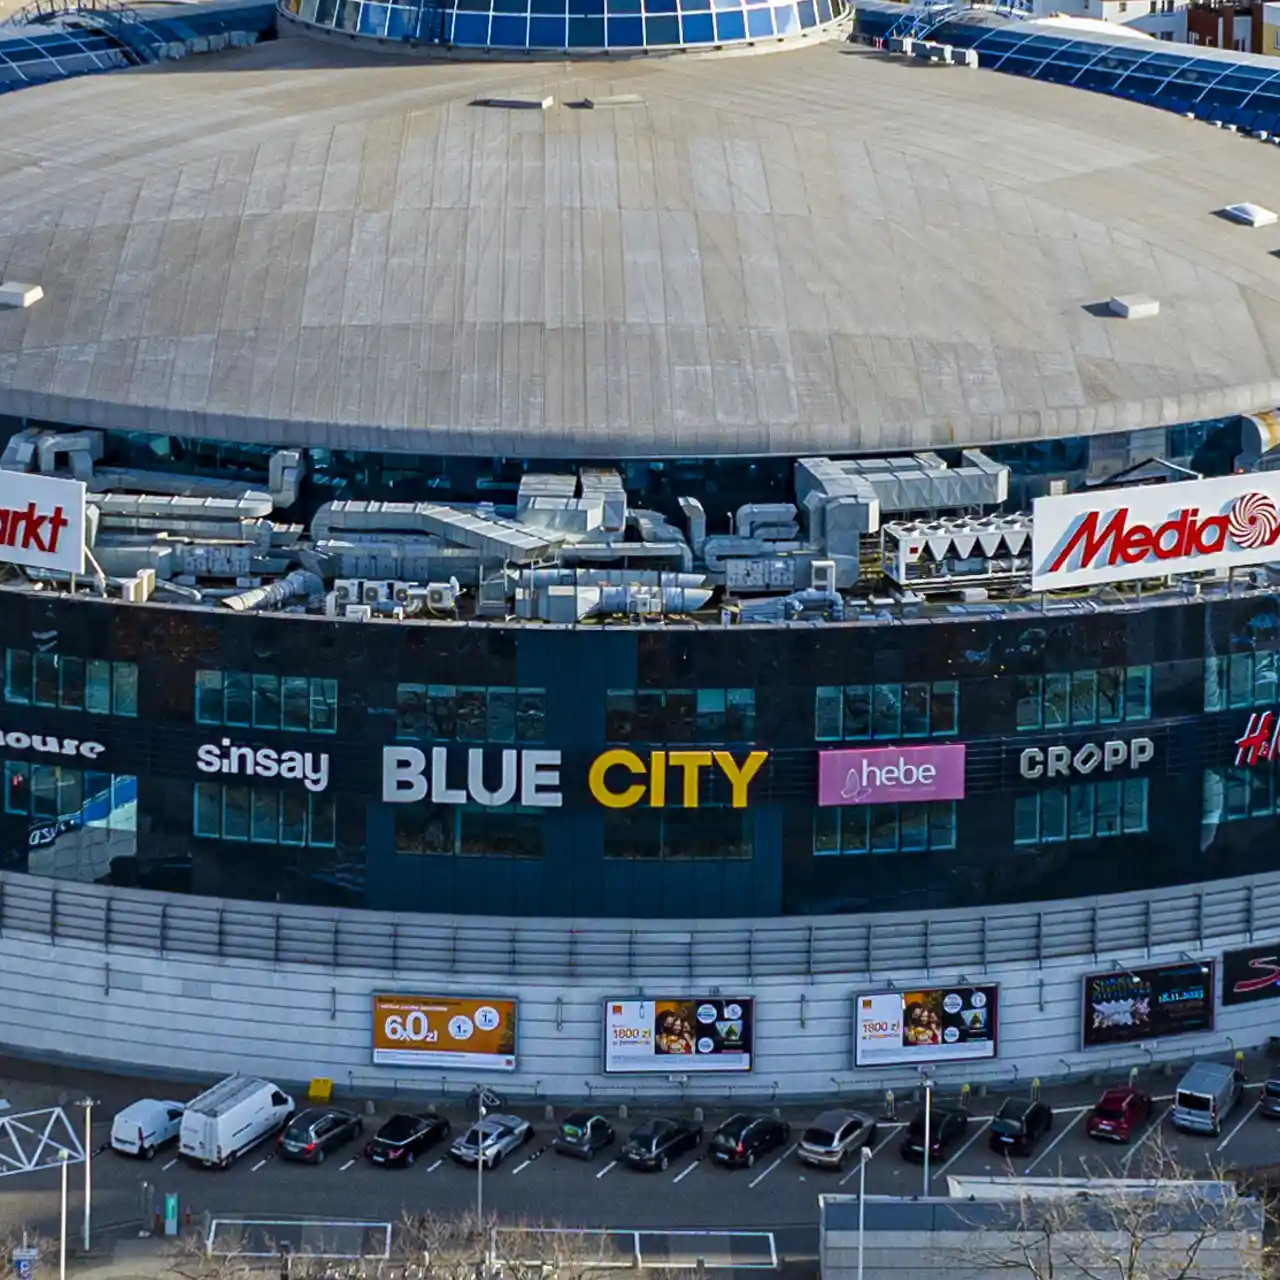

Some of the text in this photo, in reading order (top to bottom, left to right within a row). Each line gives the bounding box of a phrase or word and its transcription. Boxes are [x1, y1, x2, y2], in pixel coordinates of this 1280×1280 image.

[1049, 506, 1228, 573] Media
[196, 736, 330, 793] sinsay
[381, 745, 770, 809] BLUE CITY
[861, 756, 937, 787] hebe
[1019, 736, 1155, 780] CROPP
